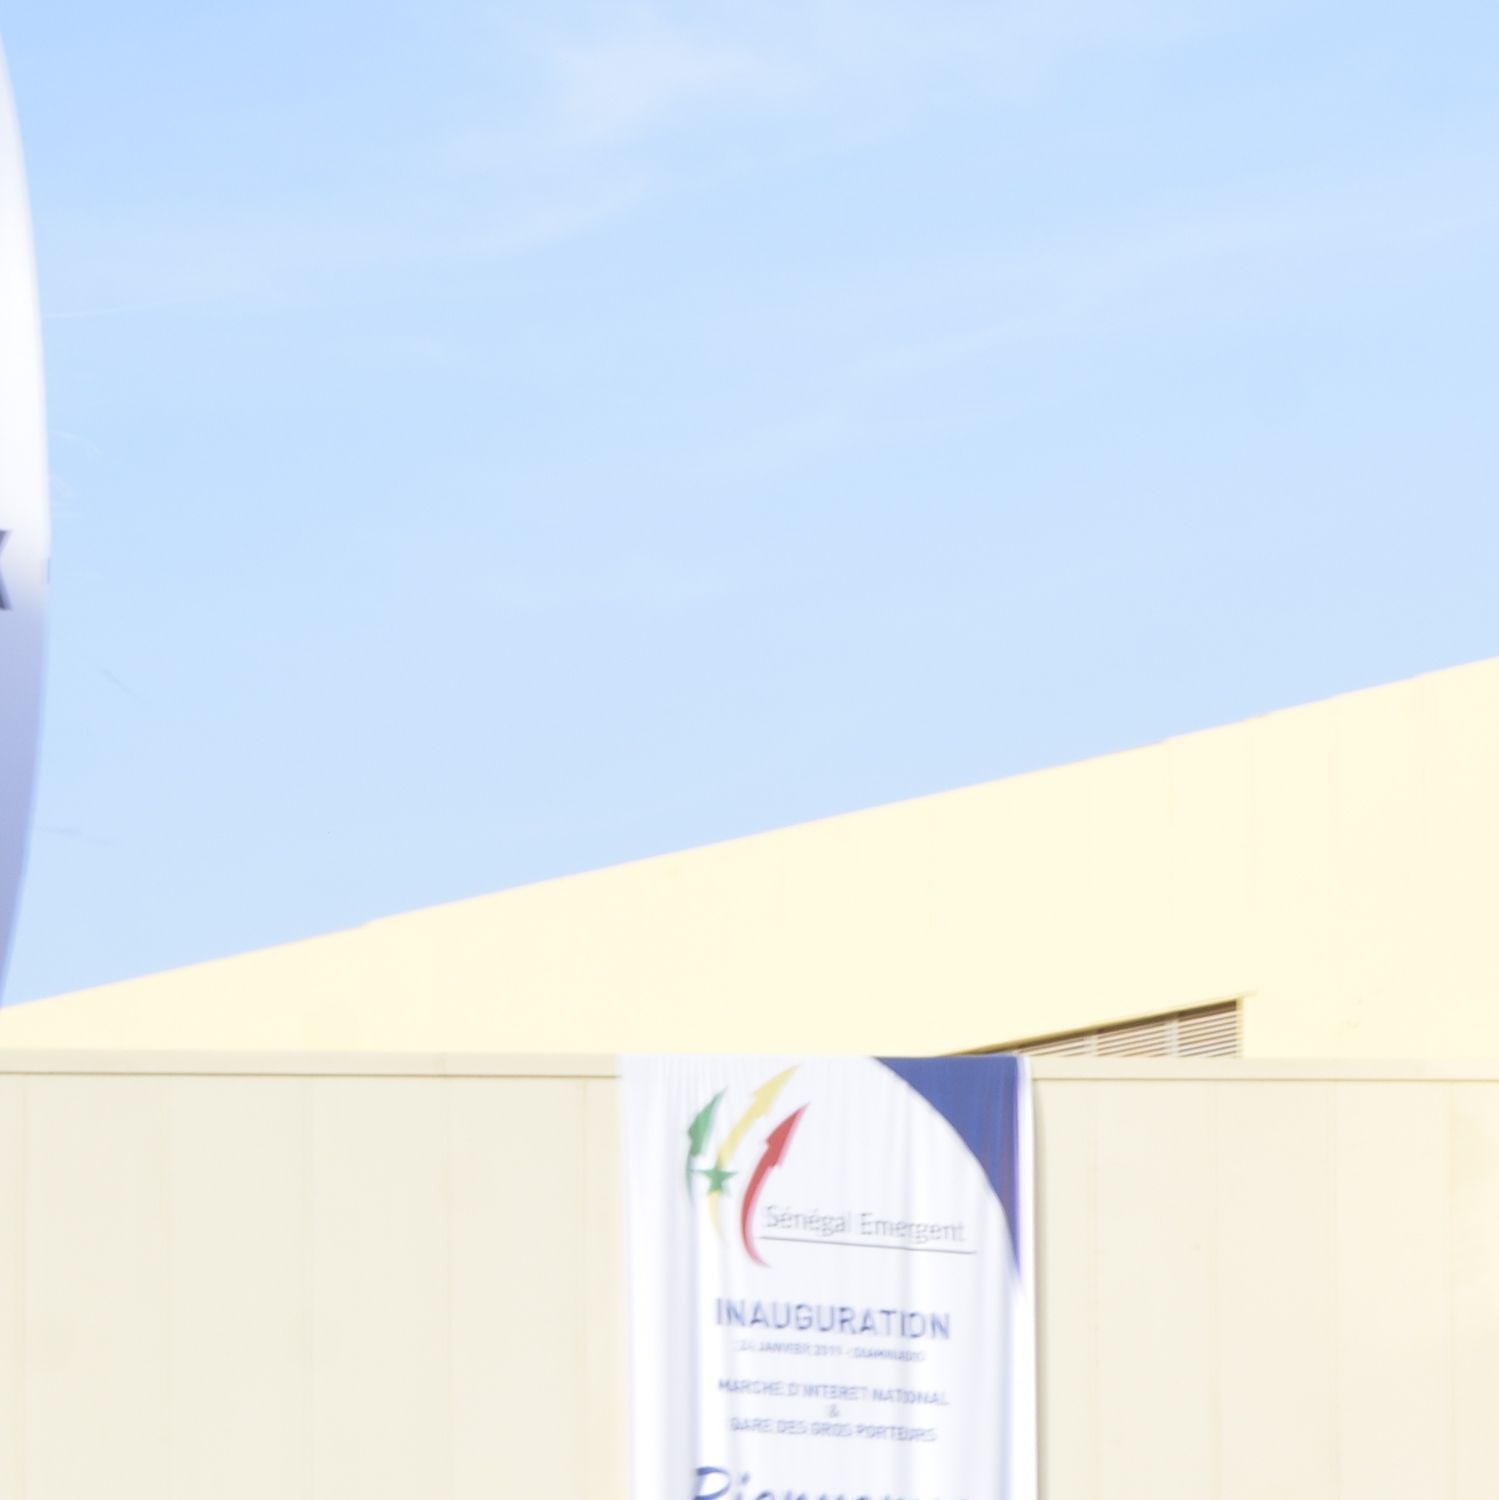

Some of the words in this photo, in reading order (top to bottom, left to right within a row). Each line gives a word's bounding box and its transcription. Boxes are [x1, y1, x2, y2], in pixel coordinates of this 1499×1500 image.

[765, 1203, 852, 1237] Sénégal
[715, 1298, 951, 1340] INAUGURATION
[718, 1377, 785, 1397] MARCHE
[872, 1386, 949, 1406] NATIONAL
[730, 1416, 772, 1433] GARE
[777, 1419, 806, 1436] DES
[811, 1421, 852, 1438] GROS
